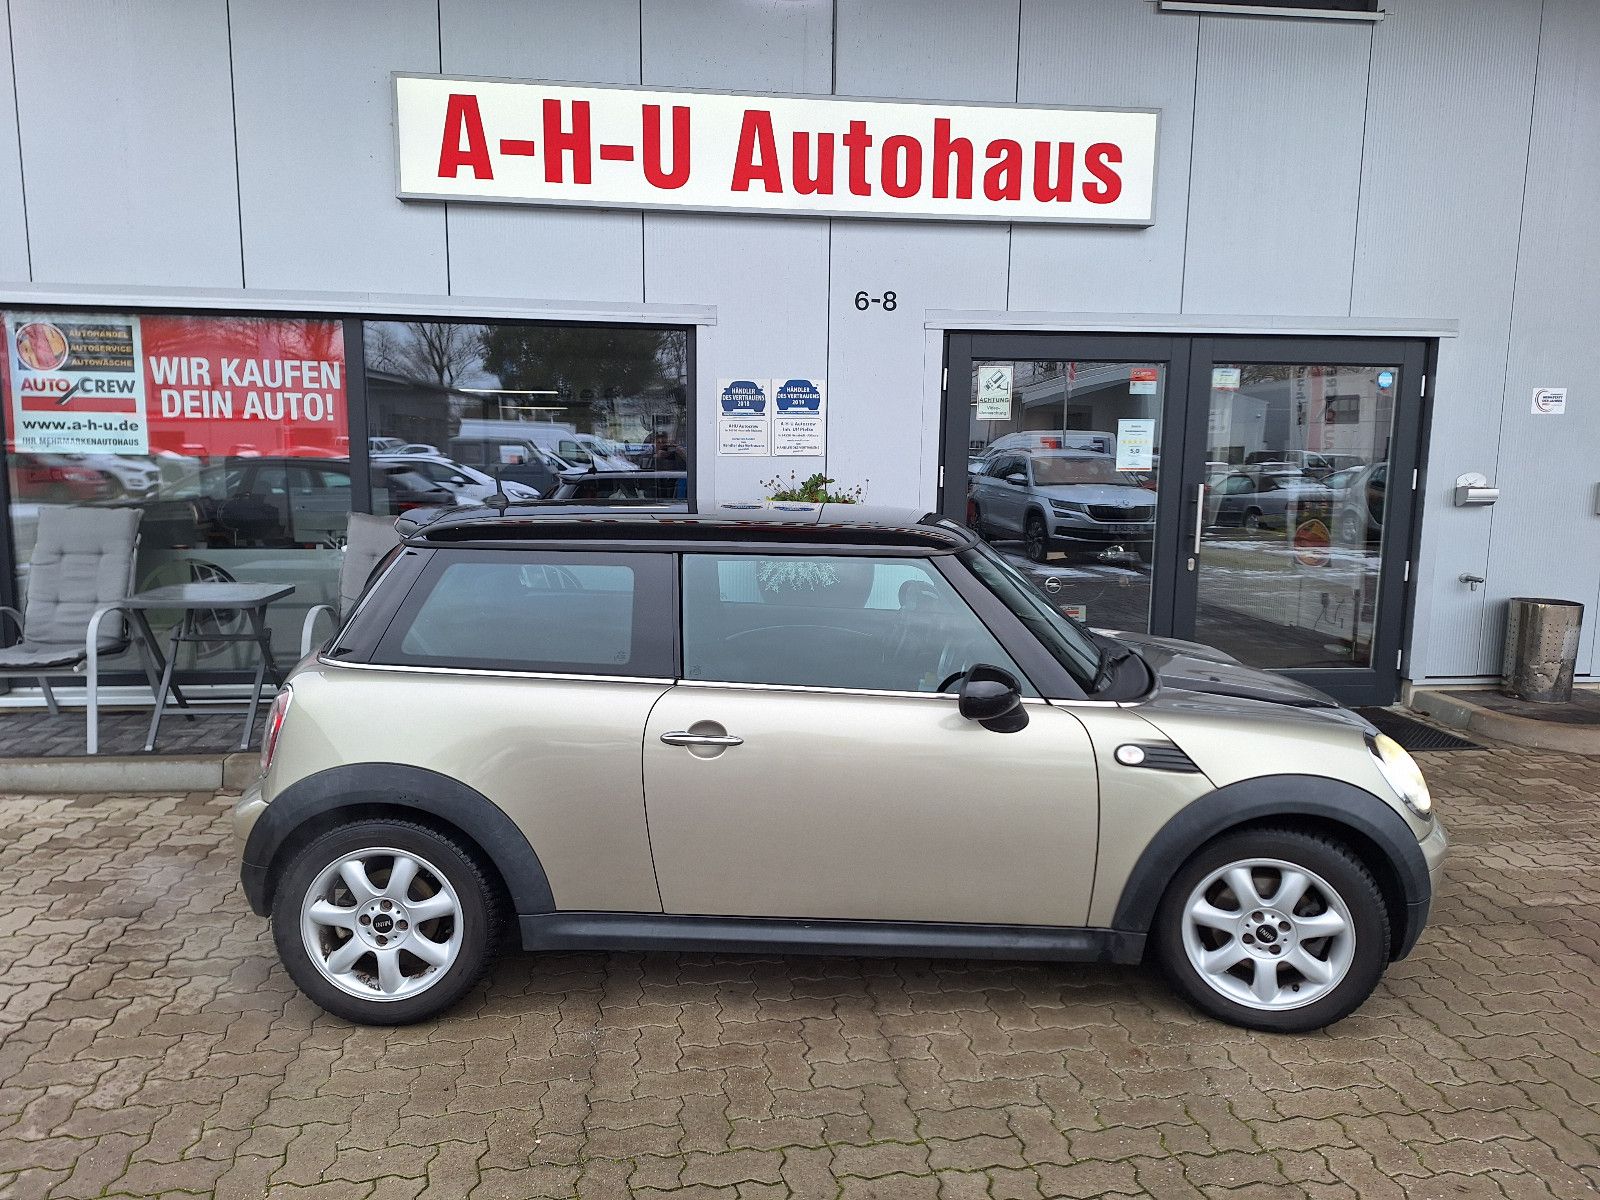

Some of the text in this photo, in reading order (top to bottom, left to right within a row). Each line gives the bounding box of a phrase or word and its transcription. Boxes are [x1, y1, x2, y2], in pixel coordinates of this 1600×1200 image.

[437, 93, 1123, 205] A-H-U Autohaus
[855, 291, 898, 312] 6-8
[69, 329, 129, 339] AUTOHANDEL
[70, 344, 132, 353] AUTOSERVICE
[149, 356, 341, 390] WIR KAUFEN
[21, 376, 136, 394] AUTO CREW
[161, 389, 335, 422] DEIN AUTO!
[23, 419, 139, 432] www.a-h-u.de
